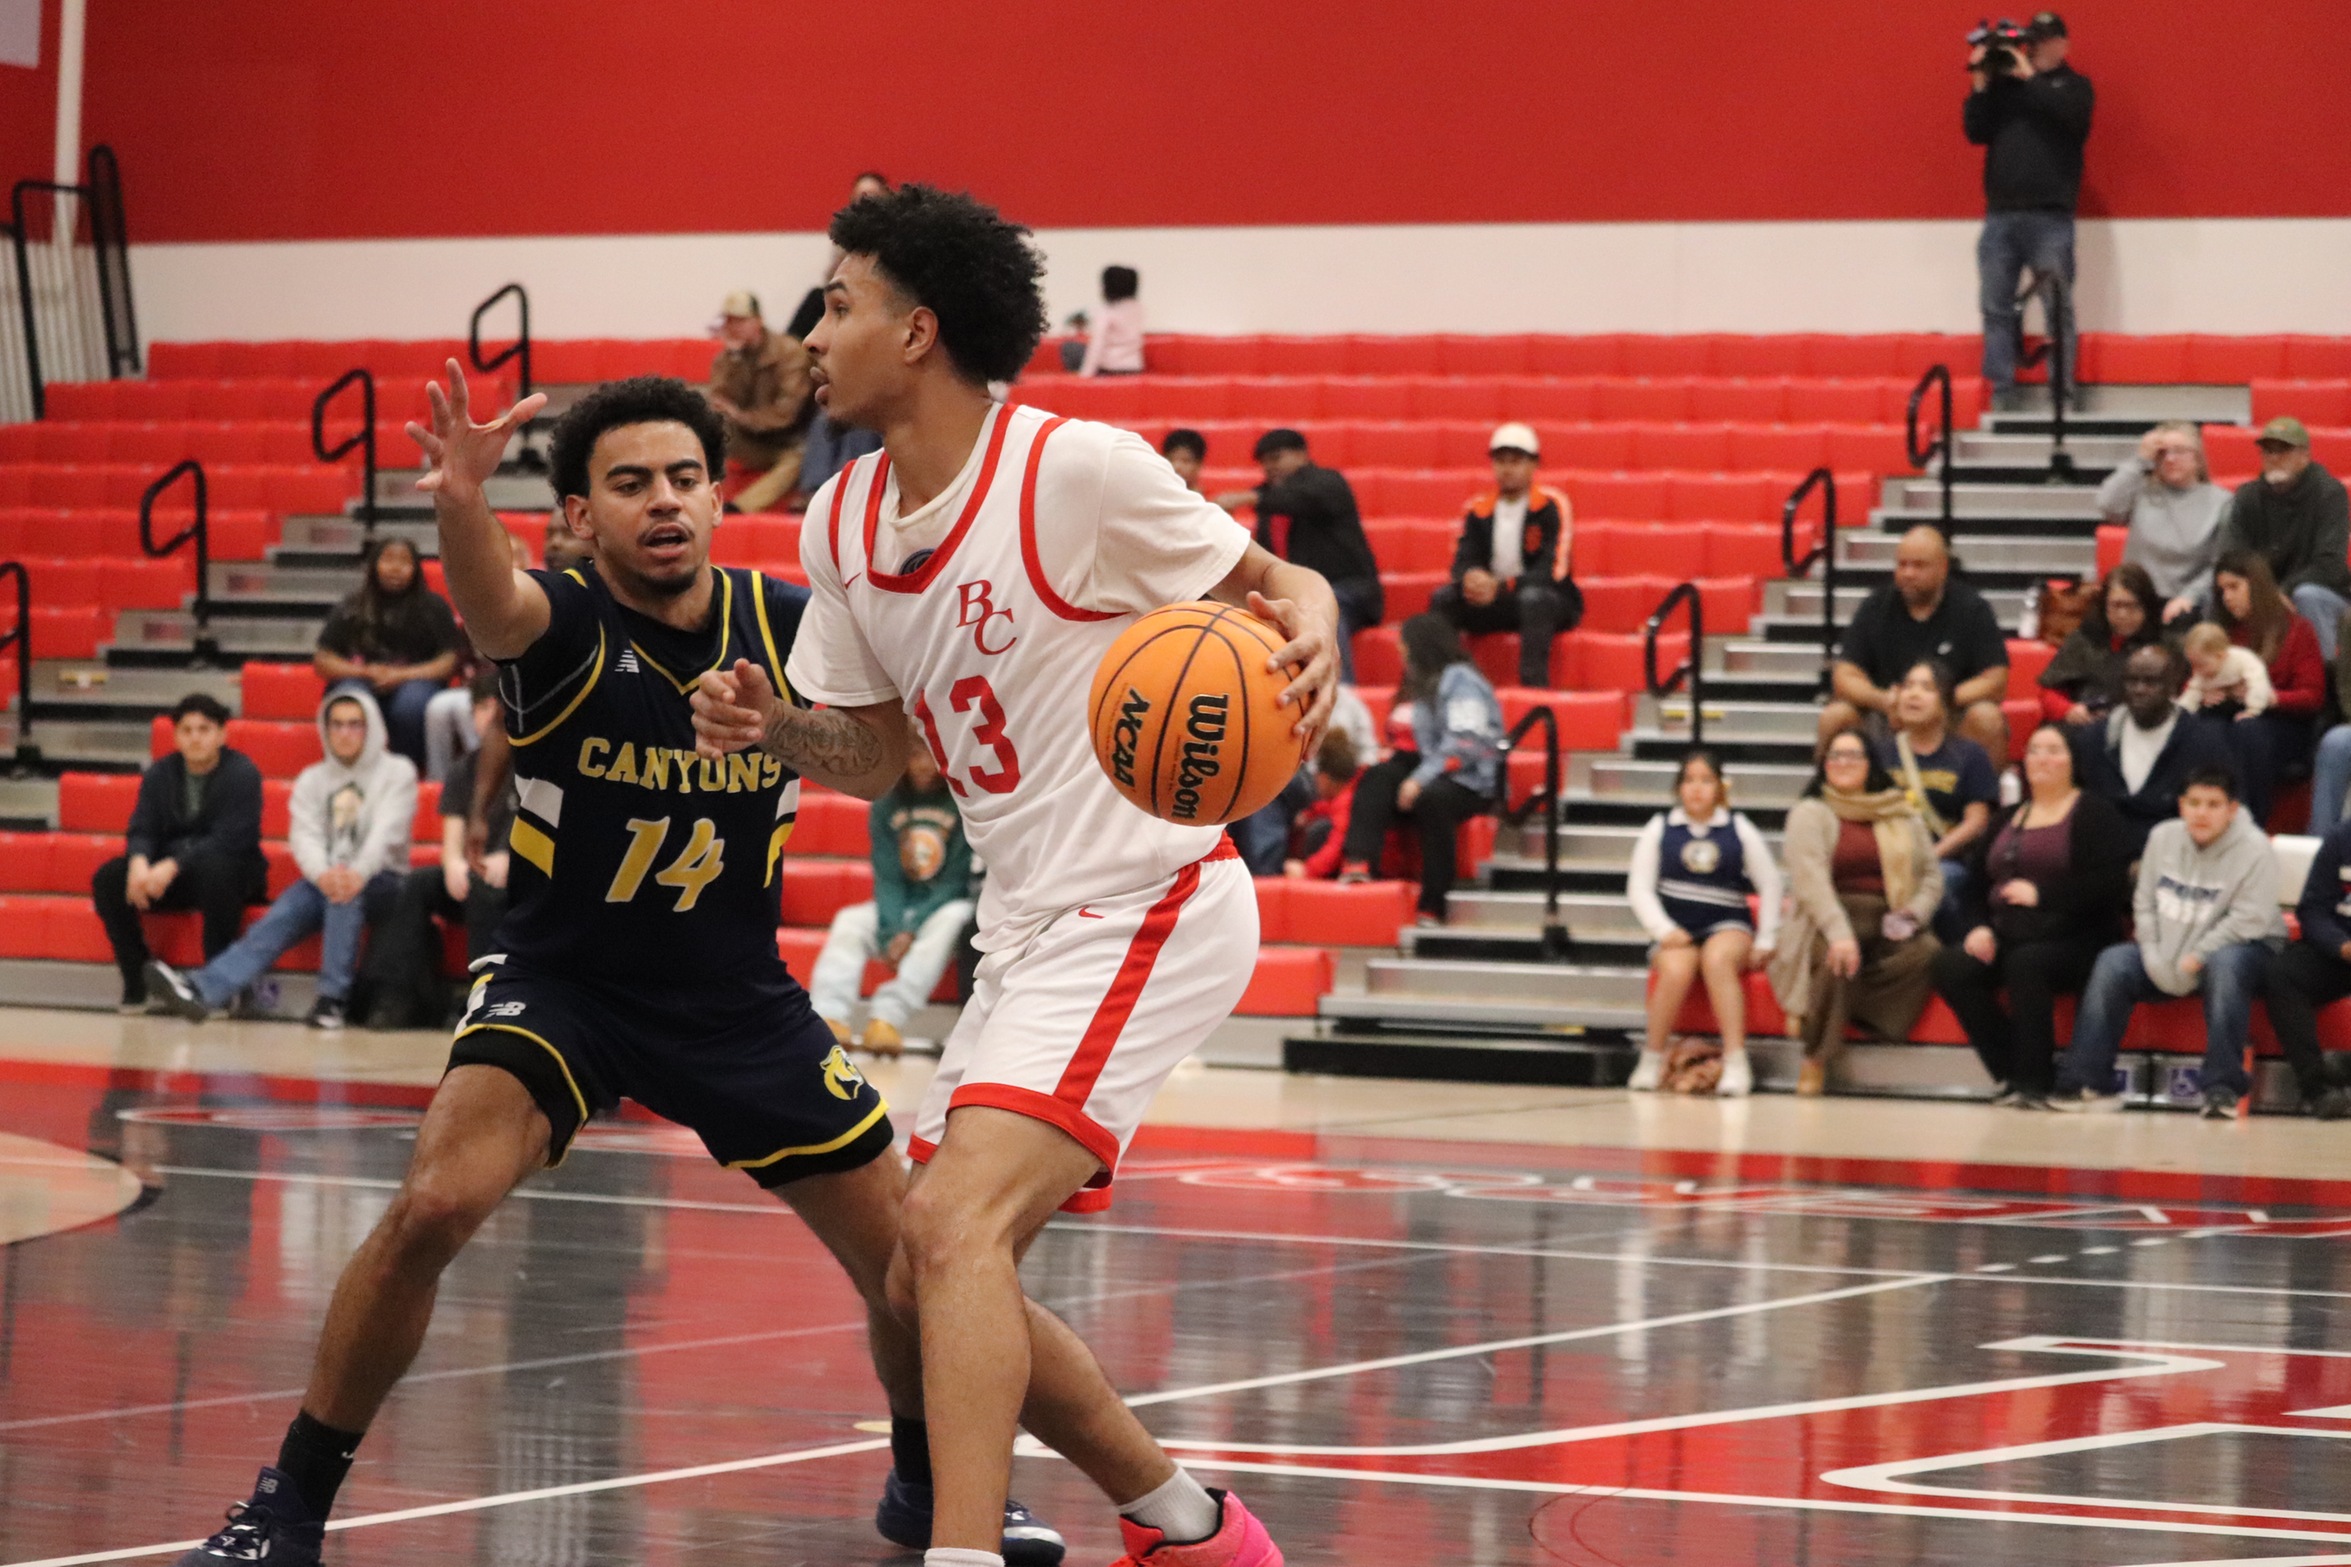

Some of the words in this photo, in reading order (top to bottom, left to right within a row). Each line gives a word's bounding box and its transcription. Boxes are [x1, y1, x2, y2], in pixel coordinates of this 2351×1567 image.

[956, 579, 1017, 655] BC
[577, 736, 782, 794] CANYONS
[914, 674, 1021, 798] 13
[1111, 687, 1151, 788] NCAA
[1171, 692, 1229, 820] Wilson
[605, 815, 725, 912] 14
